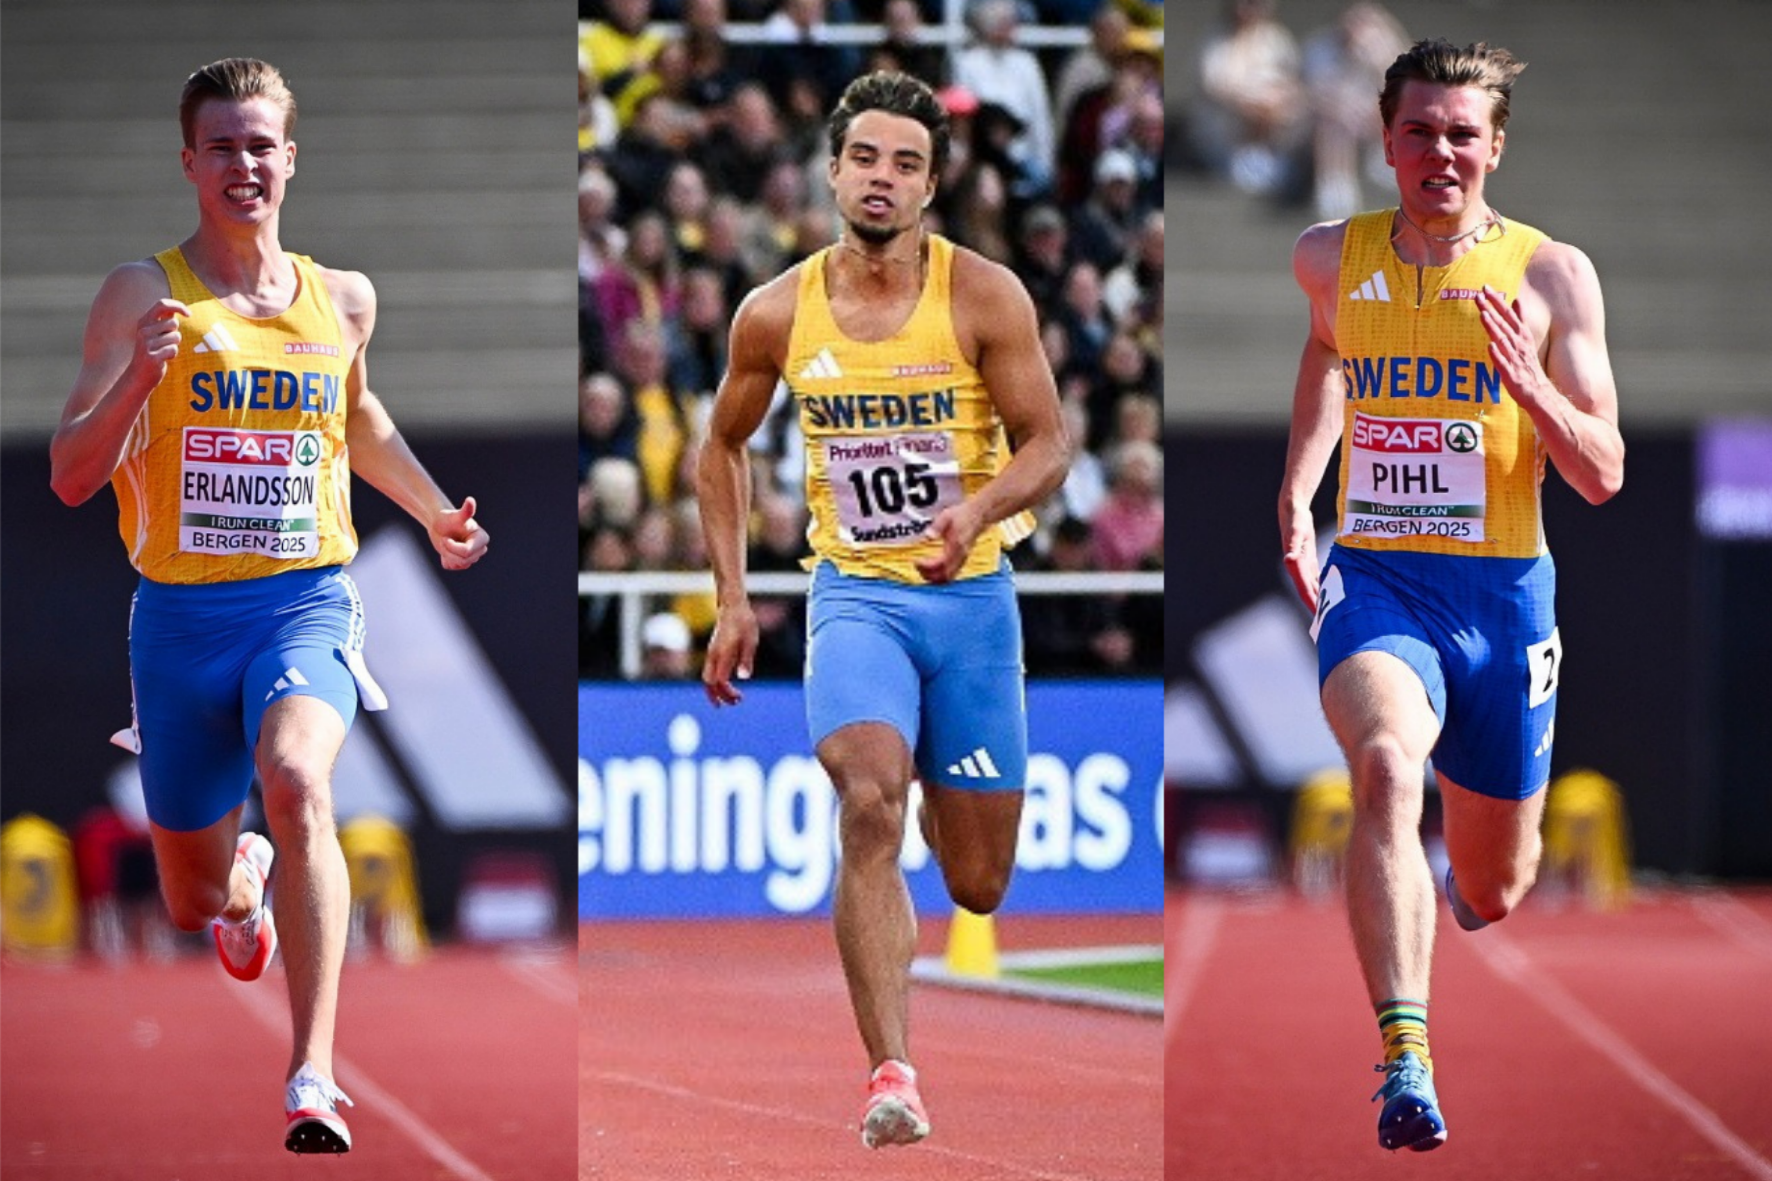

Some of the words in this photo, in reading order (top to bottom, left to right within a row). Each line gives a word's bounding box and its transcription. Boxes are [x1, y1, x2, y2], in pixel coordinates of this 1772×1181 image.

[285, 343, 338, 356] BAUHAUS
[190, 370, 339, 413] SWEDEN
[1343, 357, 1500, 403] SWEDEN
[804, 388, 954, 428] SWEDEN
[188, 434, 291, 461] SPAR
[1354, 422, 1439, 449] SPAR
[183, 471, 314, 506] ERLANDSSON
[848, 463, 938, 517] 105
[1372, 462, 1449, 494] PIHL
[217, 517, 247, 529] RUN
[850, 519, 933, 542] Sundströ
[1352, 519, 1422, 534] BERGEN
[1426, 521, 1470, 537] 2025
[192, 531, 267, 549] BERGEN
[270, 537, 306, 552] 2025
